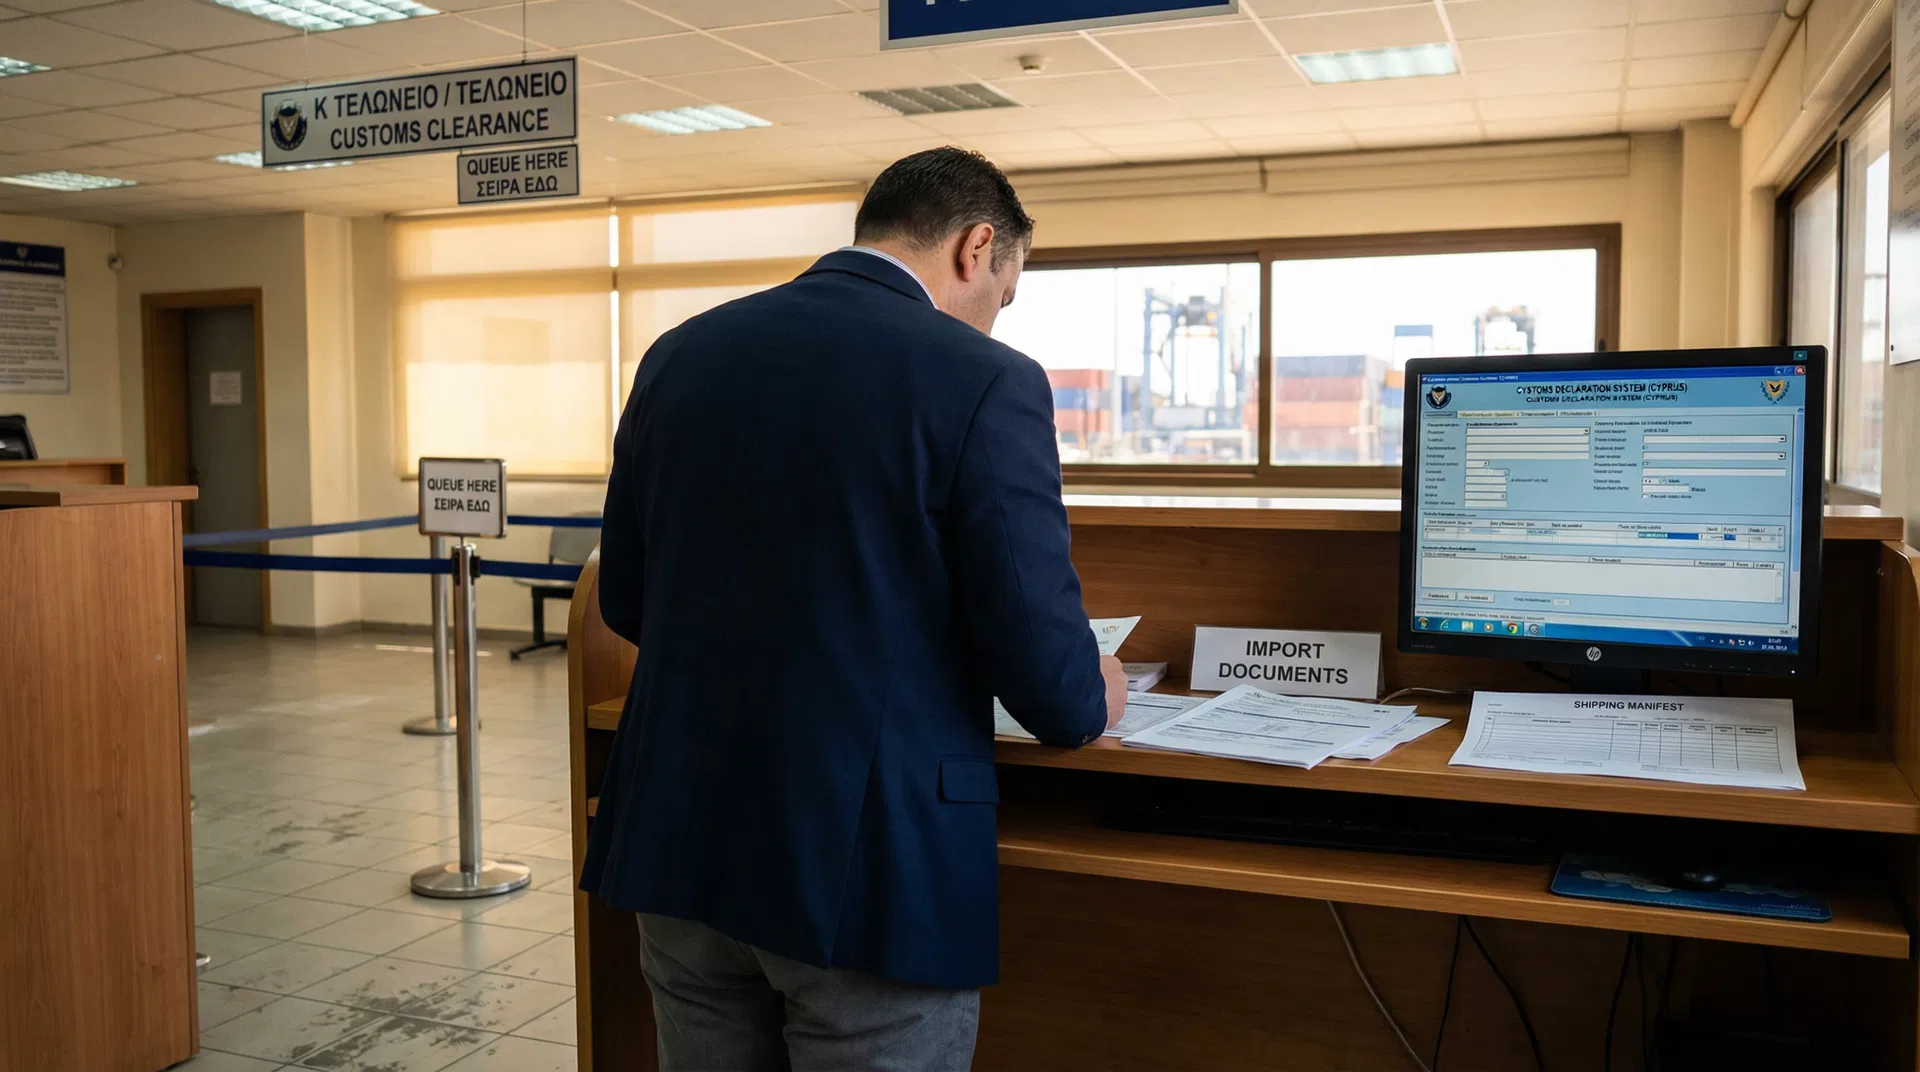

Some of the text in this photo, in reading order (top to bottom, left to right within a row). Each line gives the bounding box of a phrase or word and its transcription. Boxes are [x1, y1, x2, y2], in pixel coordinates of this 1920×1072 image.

[334, 84, 439, 119] ΤΕΛΩΝΕΙΟ
[443, 82, 451, 107] /
[455, 70, 568, 106] ΤΕΛΩΝΕΙΟ
[330, 107, 549, 150] CUSTOMS CLEARANCE
[466, 150, 569, 177] QUEUE HERE
[476, 175, 559, 198] ΣΕΙΡΑ ΕΔΩ
[1555, 384, 1611, 394] DECLARATION
[1613, 382, 1646, 393] SYSTEM
[1648, 382, 1688, 394] (CYPRUS)
[427, 478, 497, 492] QUEUE HERE
[434, 497, 491, 512] ΣΕΙΡΑ ΕΔΩ
[1245, 639, 1325, 660] IMPORT
[1218, 661, 1348, 685] DOCUMENTS
[1573, 699, 1685, 712] SHIPPING MANIFEST
